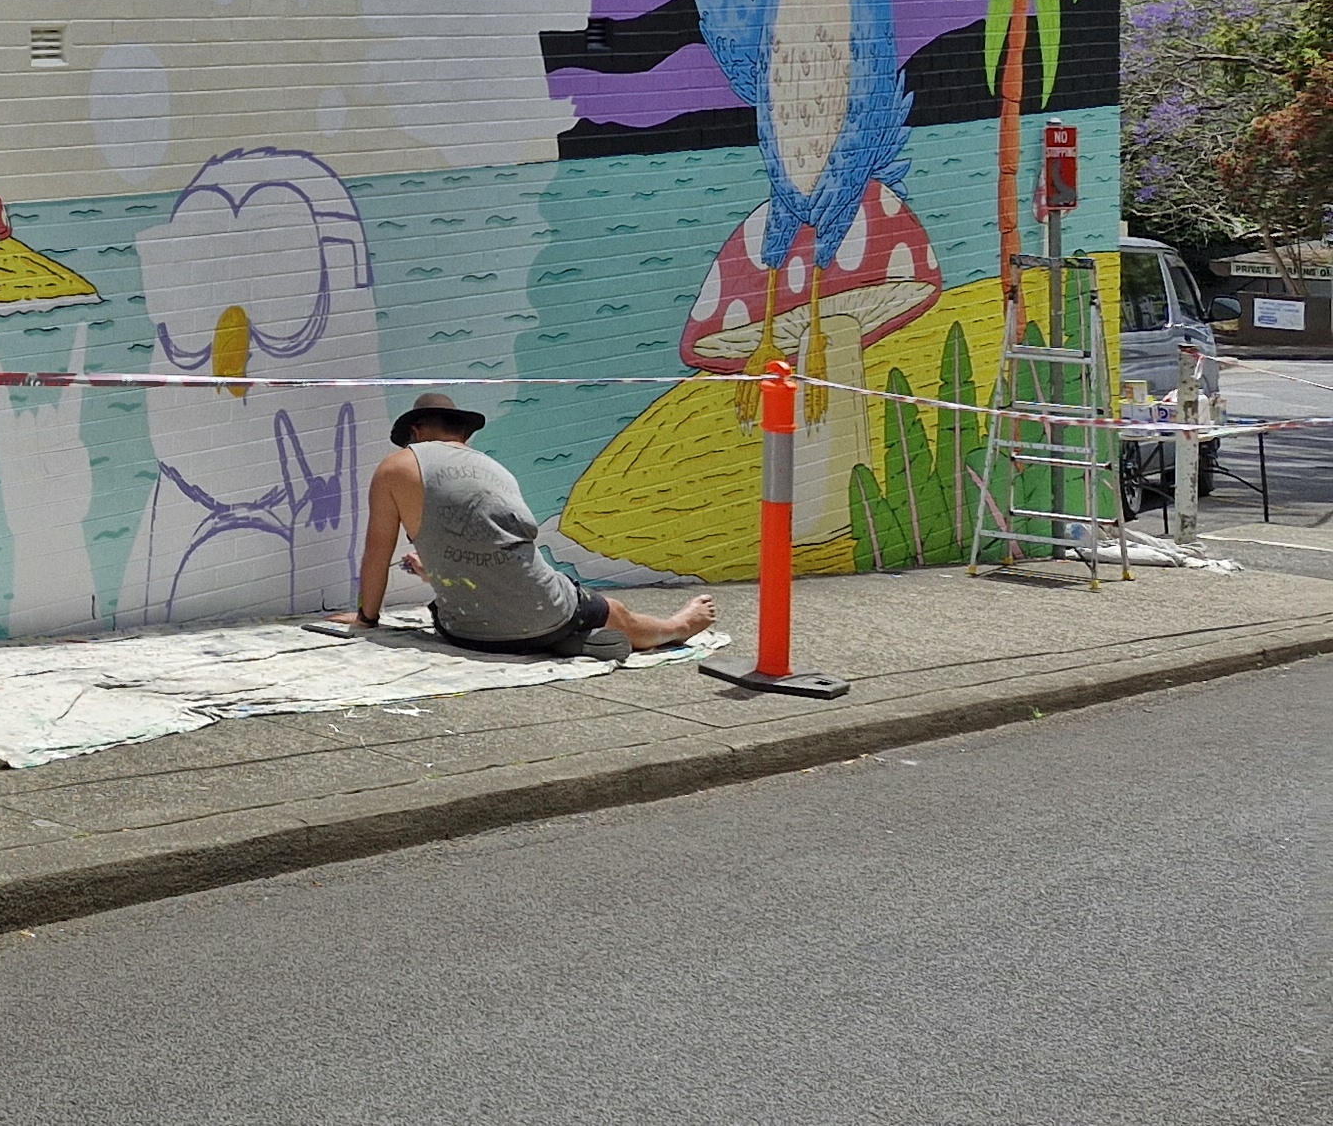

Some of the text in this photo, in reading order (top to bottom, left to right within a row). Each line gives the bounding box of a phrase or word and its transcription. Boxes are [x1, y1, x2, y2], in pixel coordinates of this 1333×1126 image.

[1053, 130, 1068, 144] NO
[1046, 147, 1076, 158] STOPPING
[1235, 265, 1272, 275] PRIVATE
